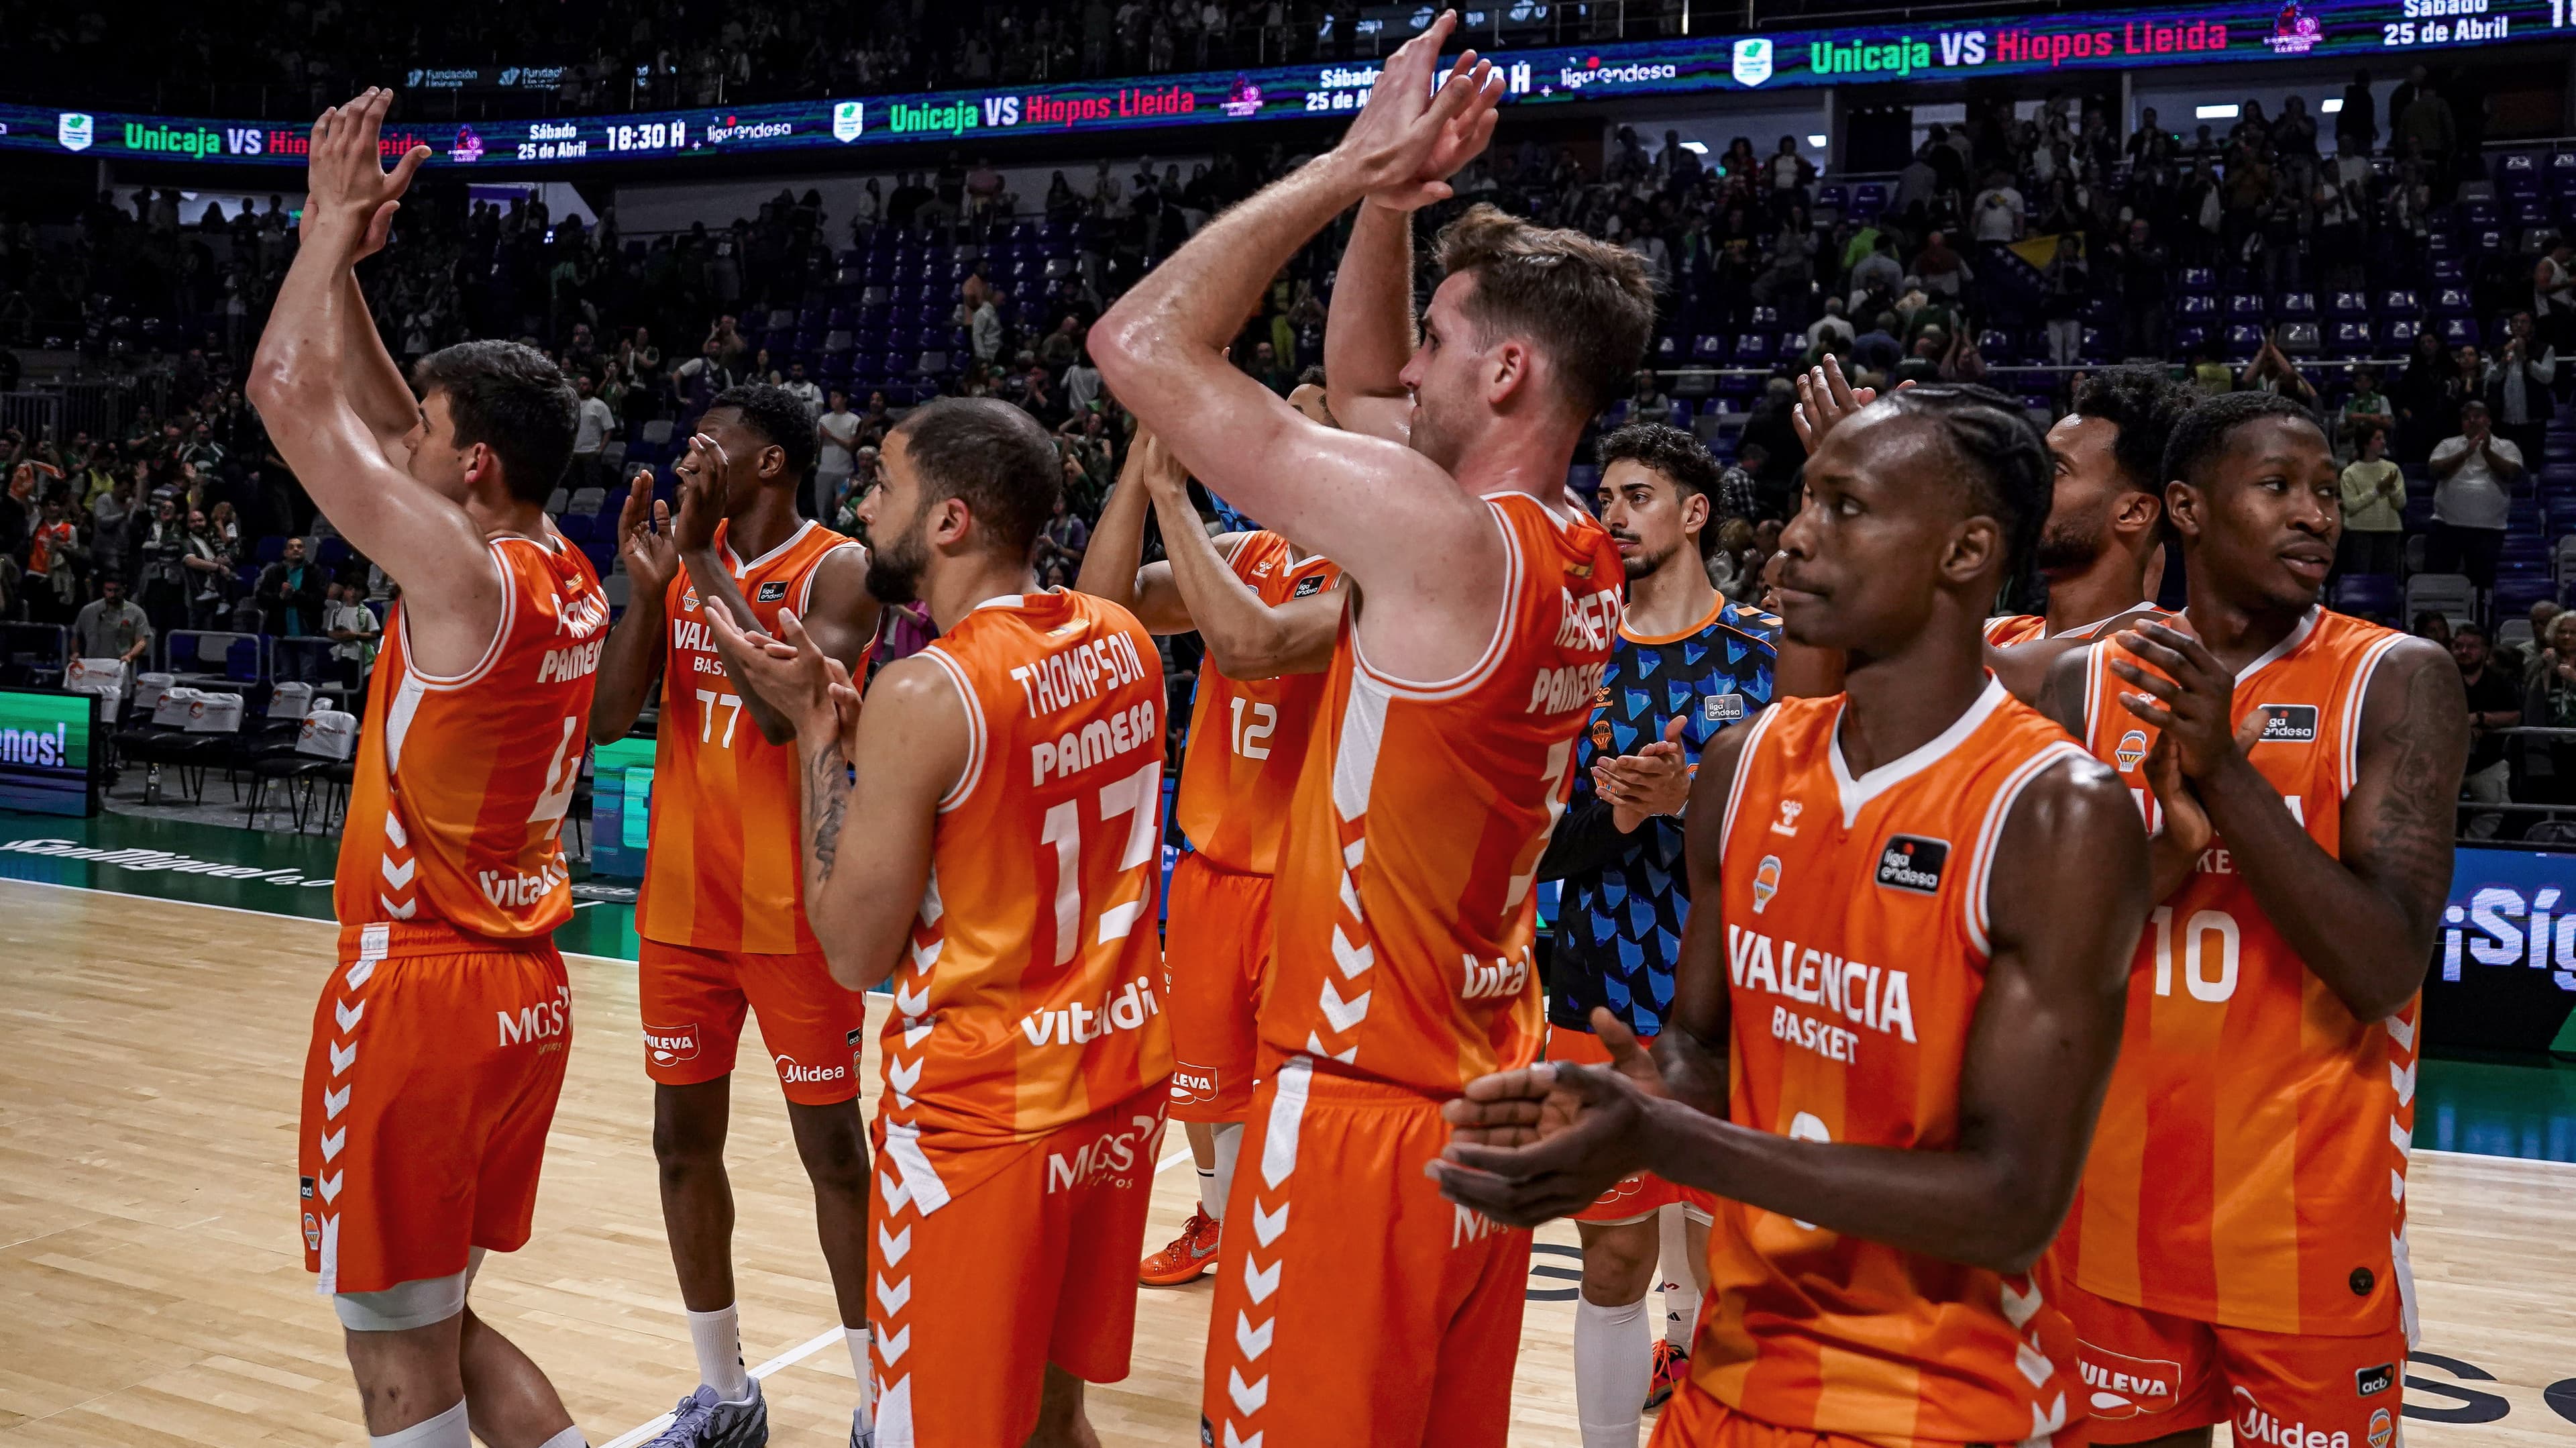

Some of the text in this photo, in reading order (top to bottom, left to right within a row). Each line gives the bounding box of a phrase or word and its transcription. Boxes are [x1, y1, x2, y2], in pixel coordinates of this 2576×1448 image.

[1811, 36, 1930, 76] Unicaja
[1940, 31, 1986, 66] VS
[1996, 29, 2112, 66] Hiopos
[2125, 21, 2226, 54] Lleida
[2383, 15, 2508, 46] 25 de Abril
[1511, 60, 1530, 94] H
[890, 100, 977, 135] Unicaja
[985, 97, 1019, 126] VS
[1026, 95, 1110, 127] Hiopos
[1119, 86, 1194, 116] Lleida
[1305, 93, 1330, 111] 25
[1332, 90, 1354, 109] de
[125, 122, 220, 159] Unicaja
[227, 128, 262, 155] VS
[518, 140, 587, 160] 25 de Abril
[529, 122, 577, 141] Sábado
[606, 119, 686, 151] 18:30 H
[1010, 631, 1145, 719] THOMPSON
[696, 688, 743, 749] 77
[1709, 702, 1723, 711] liga
[1709, 707, 1740, 717] endesa
[0, 721, 65, 766] nos!
[1032, 700, 1155, 787] PAMESA
[1230, 696, 1277, 760] 12
[1880, 864, 1937, 888] endesa
[1884, 849, 1910, 868] liga
[2151, 906, 2240, 1002] 10
[1729, 924, 1917, 1043] VALENCIA
[1772, 1005, 1858, 1065] BASKET
[780, 1064, 845, 1083] Midea
[1047, 1133, 1135, 1194] MGS
[2077, 1358, 2167, 1396] ULEVA
[2362, 1377, 2387, 1393] acb
[2238, 1408, 2349, 1448] Midea
